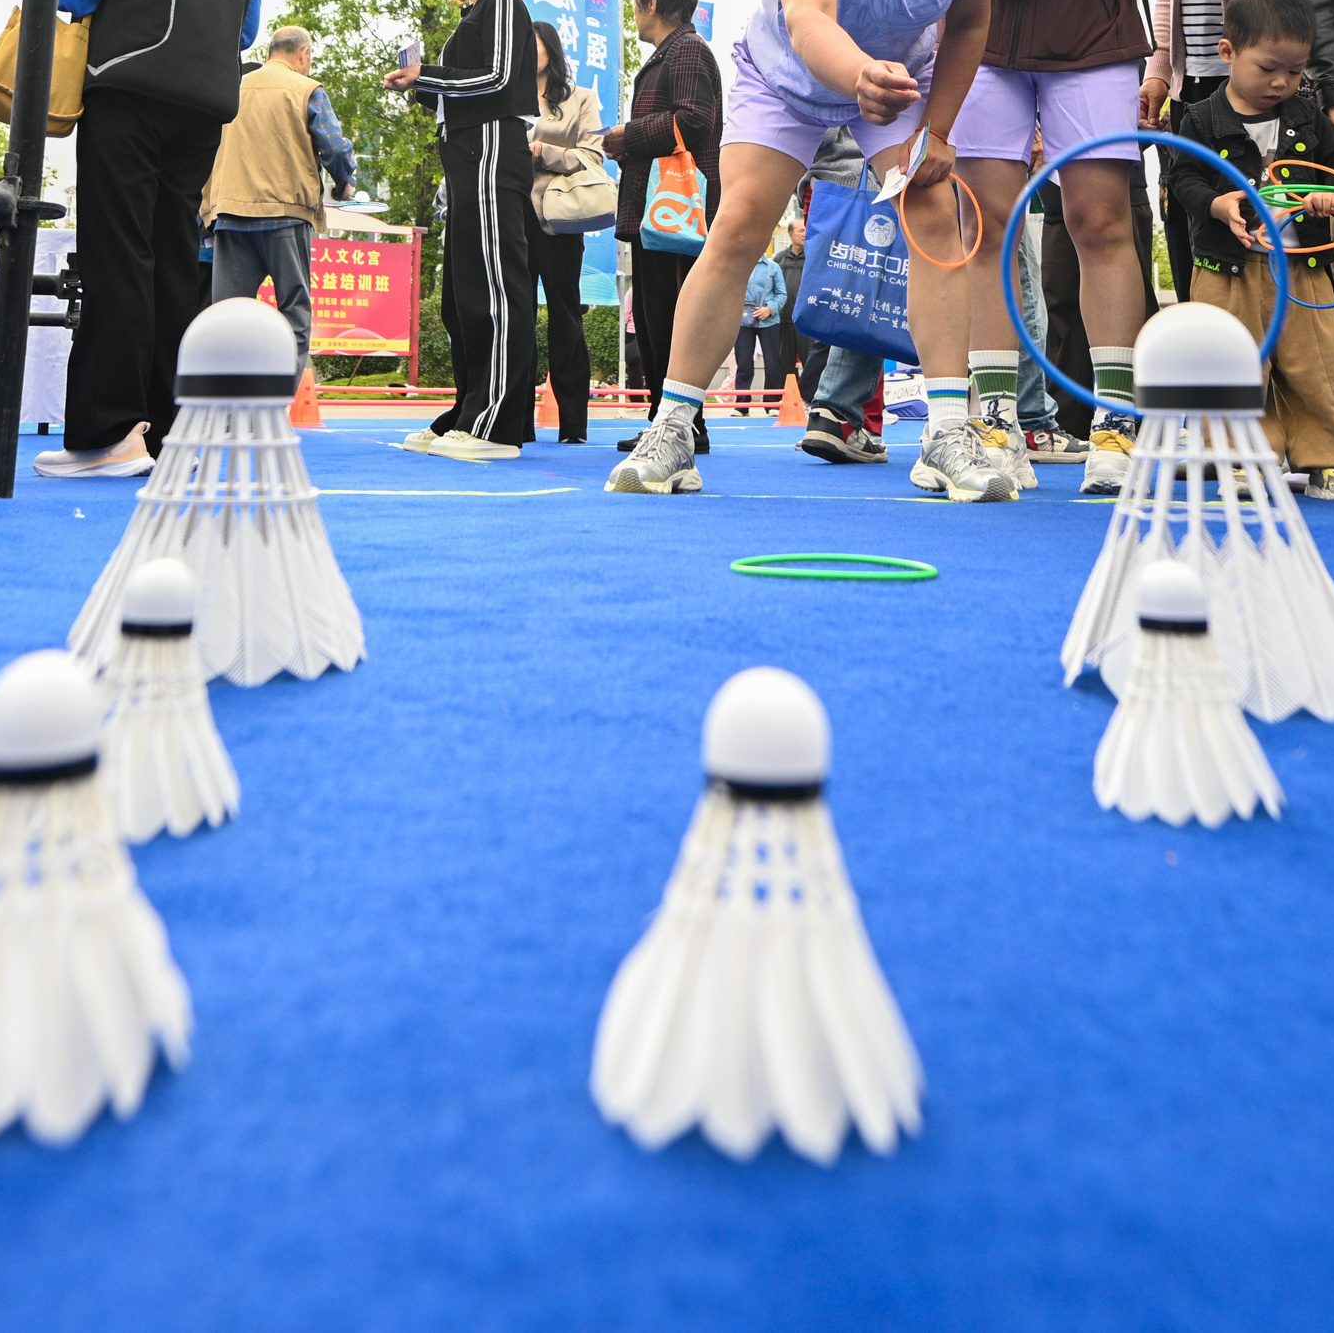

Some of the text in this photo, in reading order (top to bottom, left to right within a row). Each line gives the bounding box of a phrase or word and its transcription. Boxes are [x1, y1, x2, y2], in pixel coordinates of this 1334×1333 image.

[826, 259, 908, 287] CHIBOSHI ORAL CAV
[807, 294, 862, 318] 做一次治疗
[821, 286, 865, 306] 一城三院
[892, 383, 923, 400] YONEX
